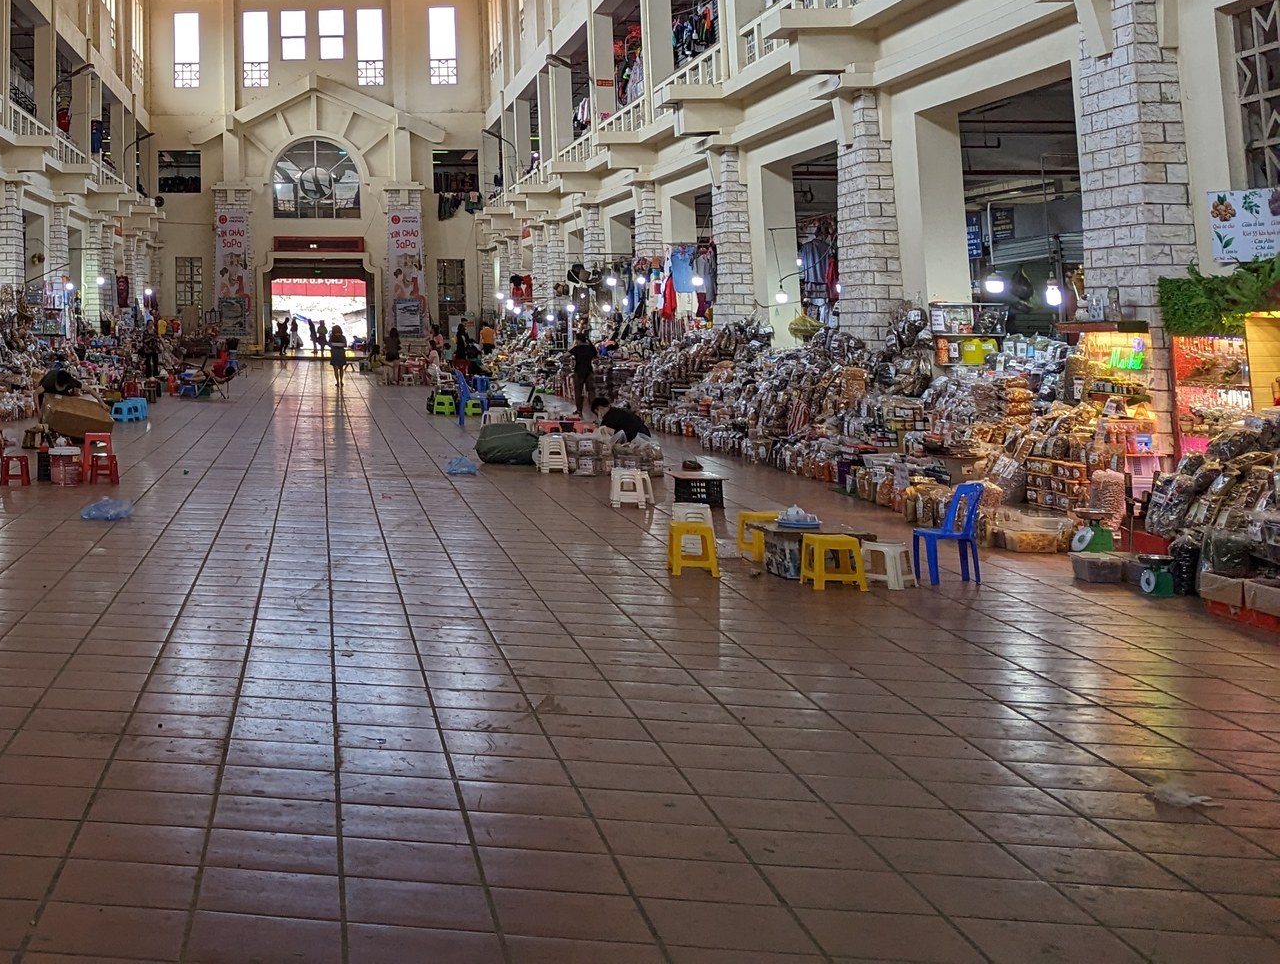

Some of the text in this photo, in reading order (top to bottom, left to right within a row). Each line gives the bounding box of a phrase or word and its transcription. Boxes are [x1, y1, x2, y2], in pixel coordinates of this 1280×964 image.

[222, 239, 242, 249] SaPa
[395, 239, 417, 249] SaPa
[1107, 347, 1144, 370] Market
